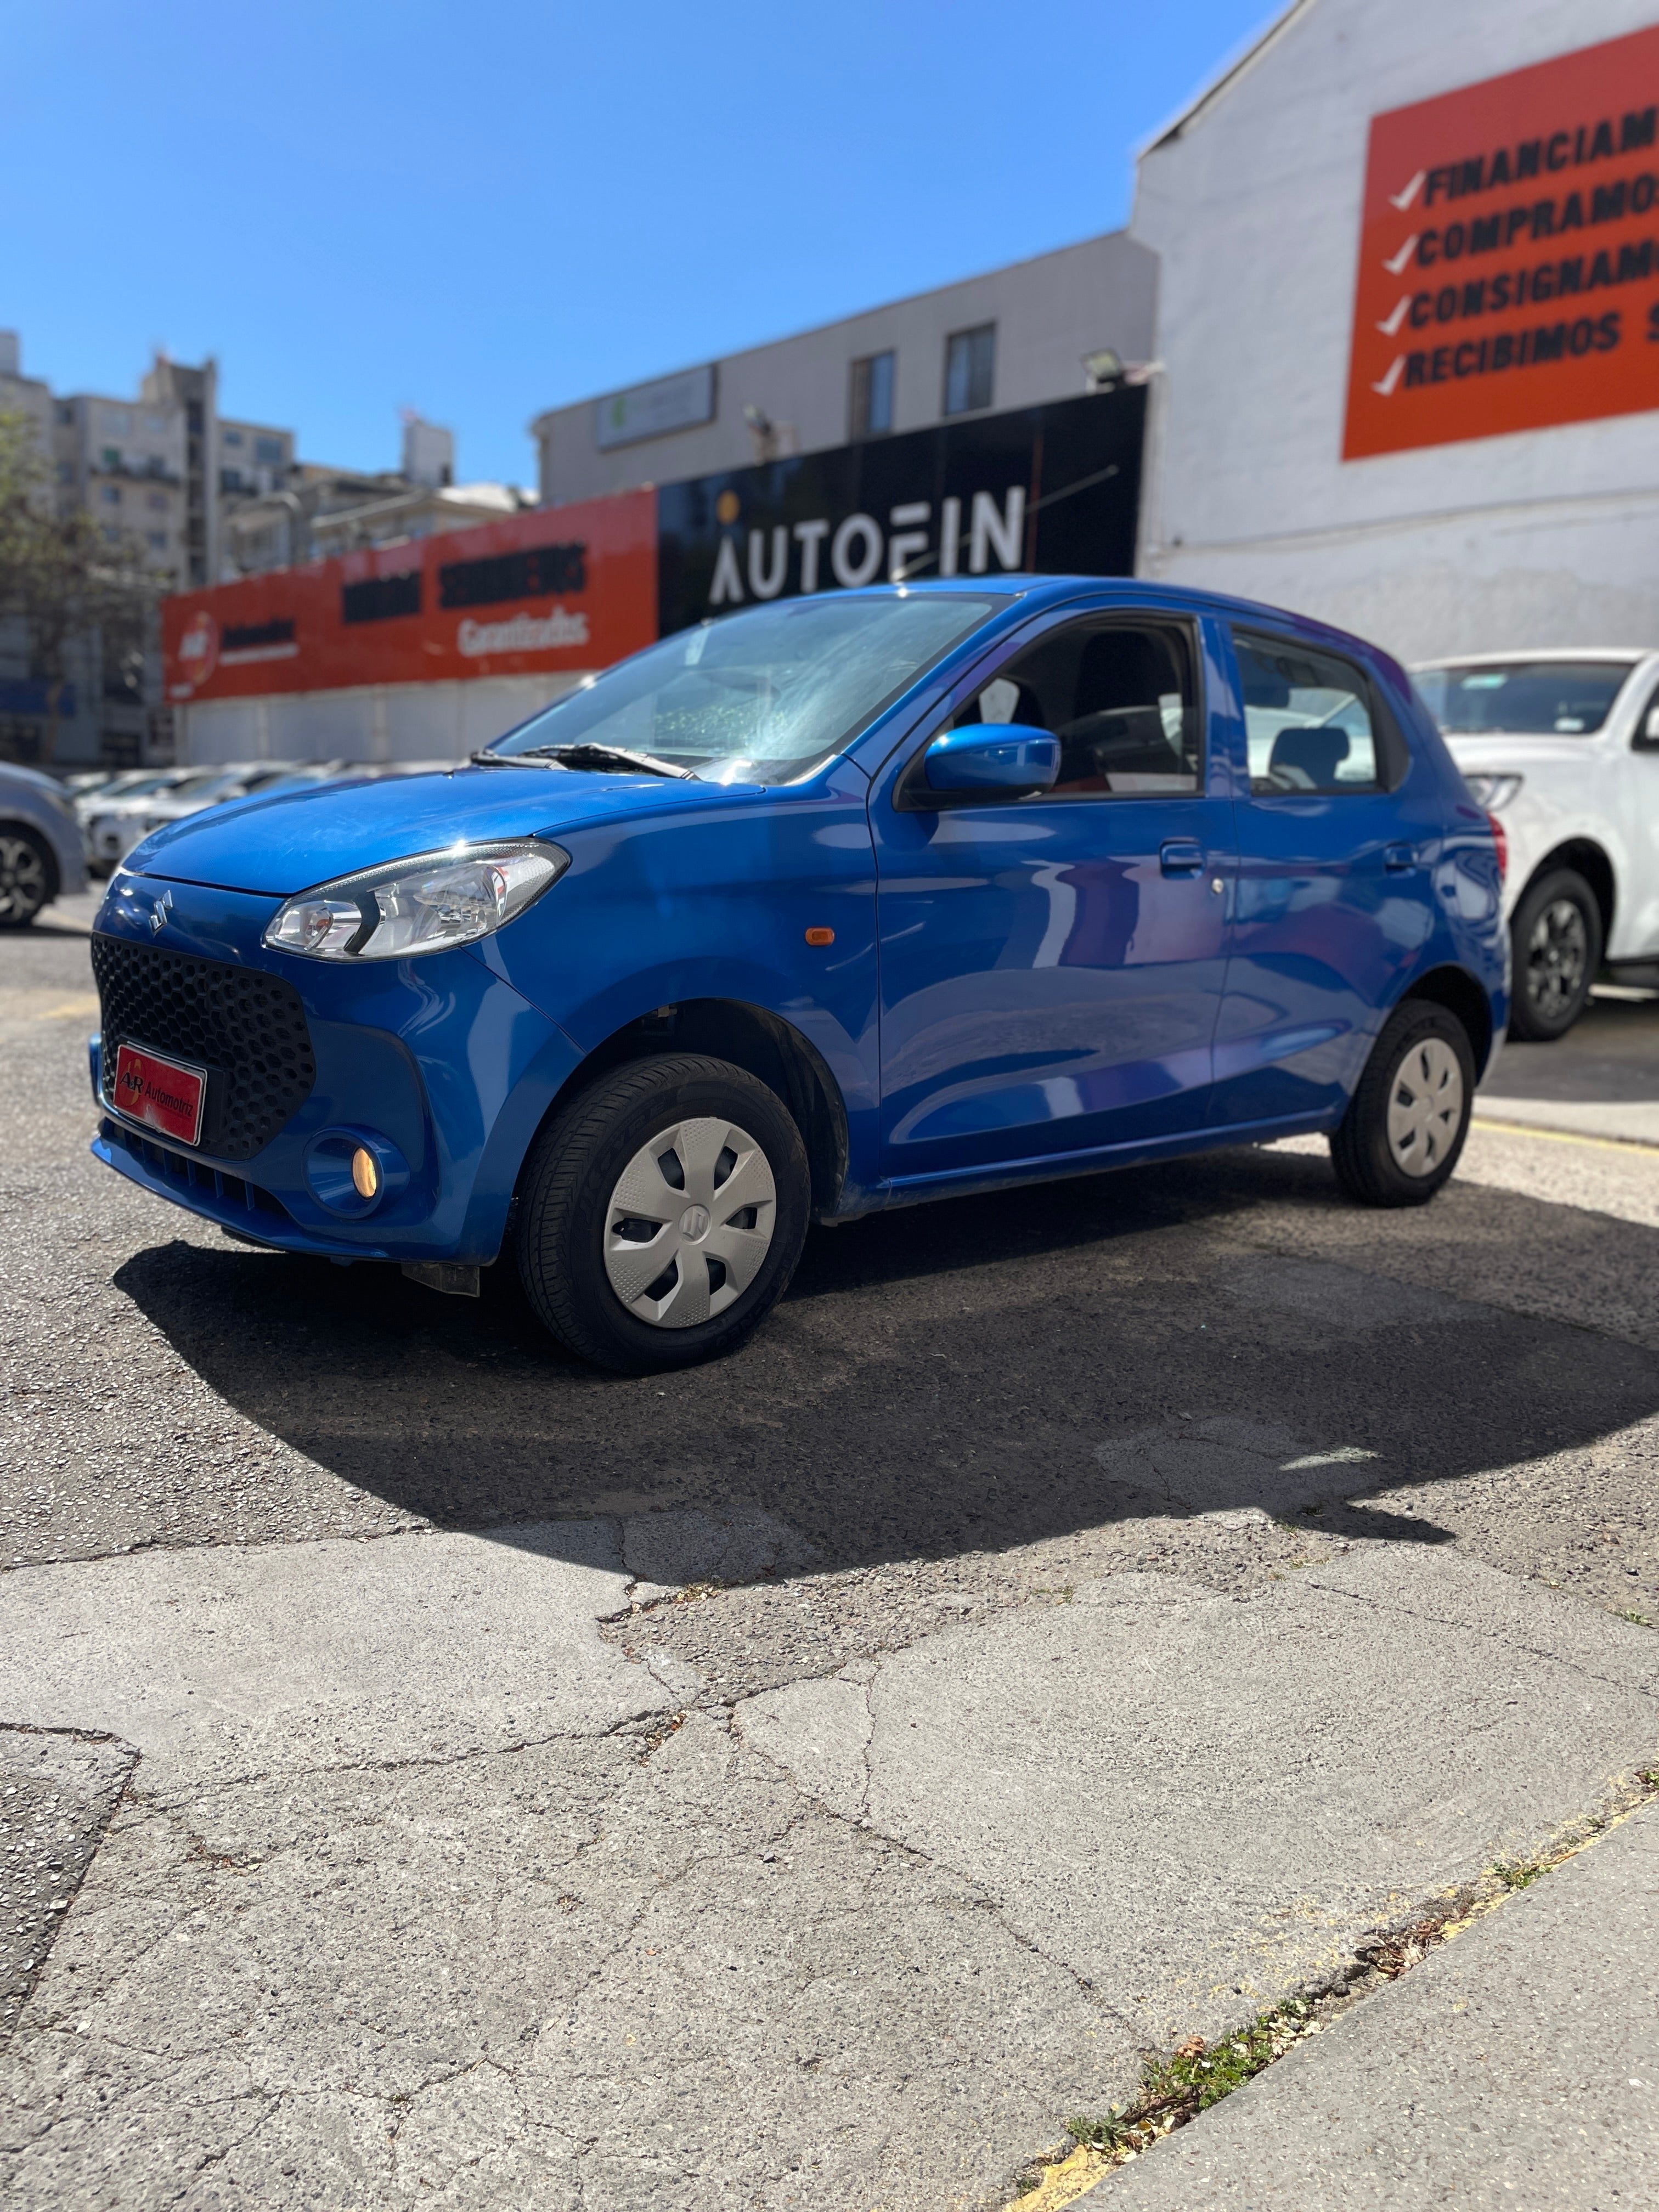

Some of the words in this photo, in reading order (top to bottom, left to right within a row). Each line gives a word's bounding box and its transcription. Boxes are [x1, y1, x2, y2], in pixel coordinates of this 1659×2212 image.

[1417, 173, 1659, 267] COMPRAMO
[1410, 239, 1659, 329] CONSIGNAM
[1404, 312, 1622, 388] RECIBIMOS
[709, 486, 1025, 603] AUTOFIN
[145, 1082, 194, 1117] Automotriz
